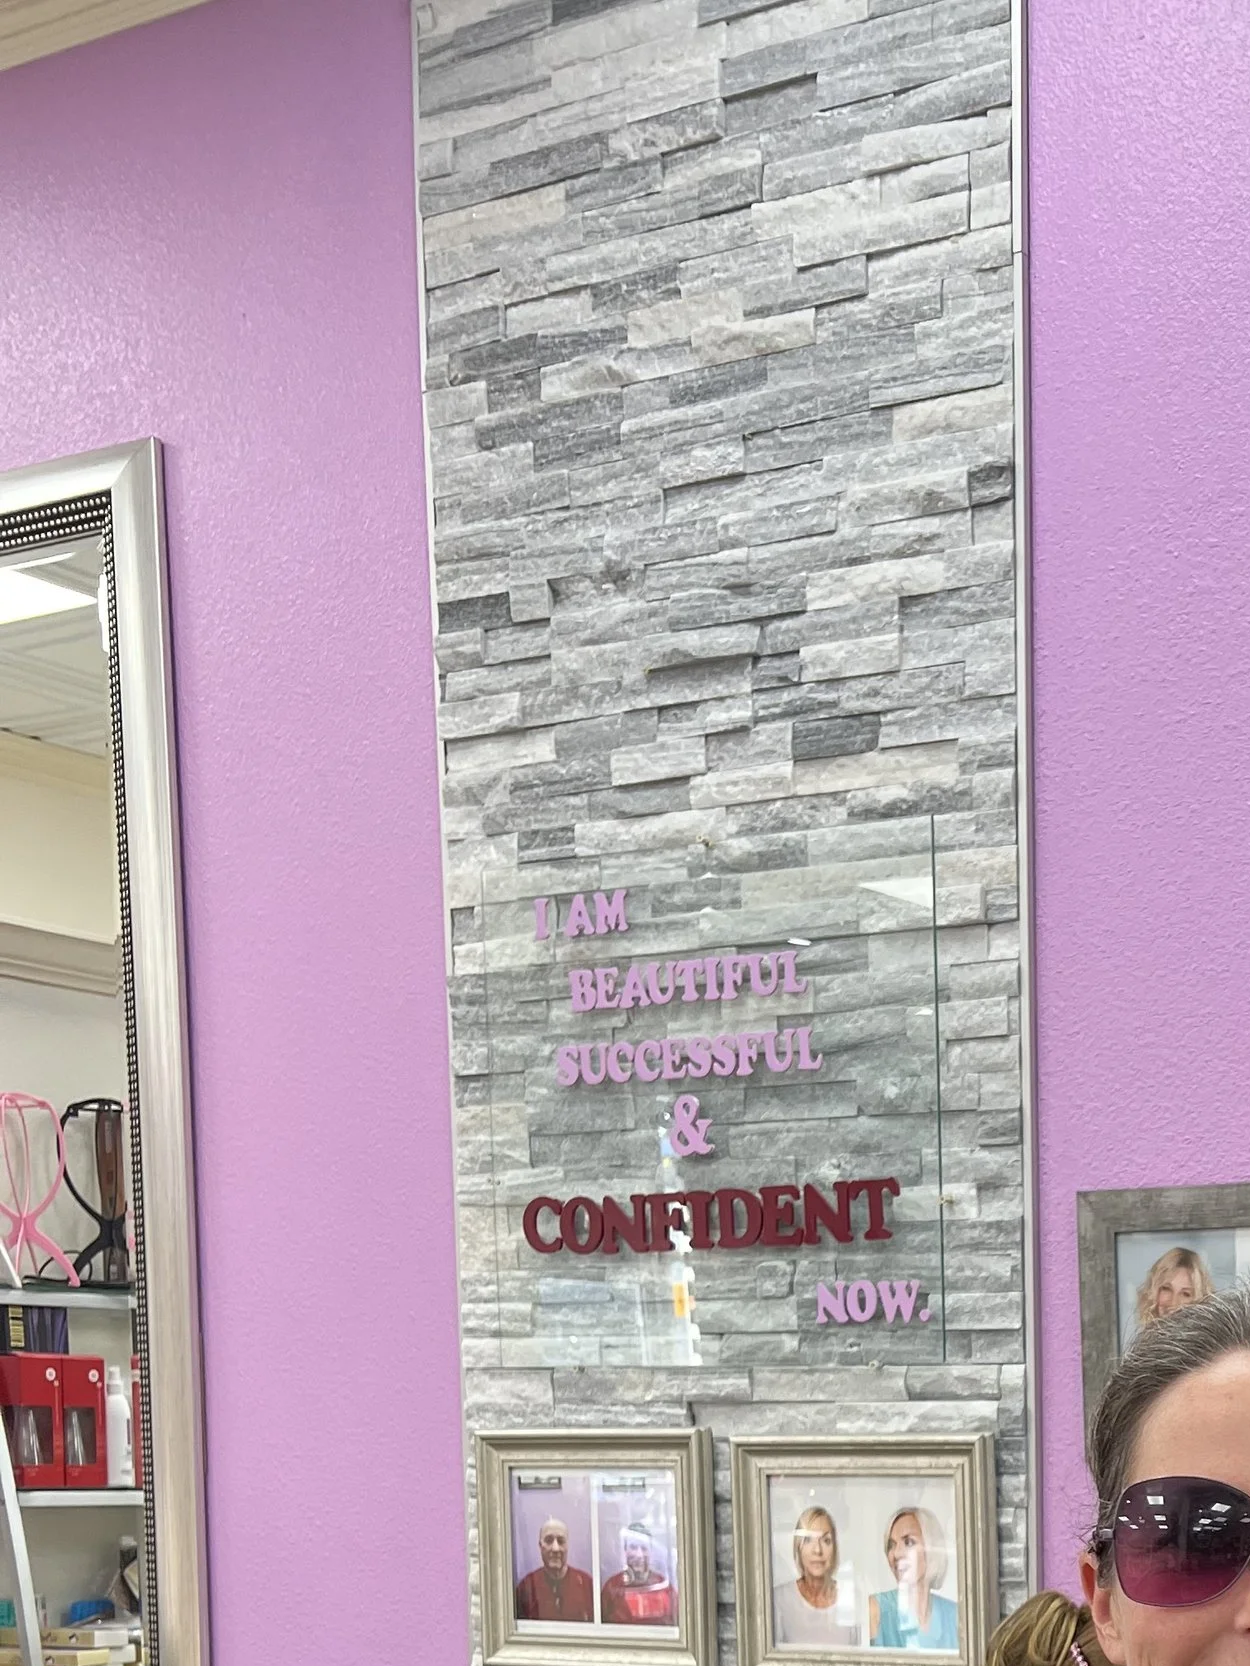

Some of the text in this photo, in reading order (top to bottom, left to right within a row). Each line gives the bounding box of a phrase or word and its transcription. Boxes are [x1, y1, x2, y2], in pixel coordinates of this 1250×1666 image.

[534, 889, 630, 941] I AM
[568, 950, 809, 1013] BEAUTIFUL
[557, 1026, 824, 1087] SUCCESSFUL
[670, 1094, 715, 1157] &
[522, 1176, 901, 1256] CONFIDENT
[815, 1279, 932, 1325] NOW.
